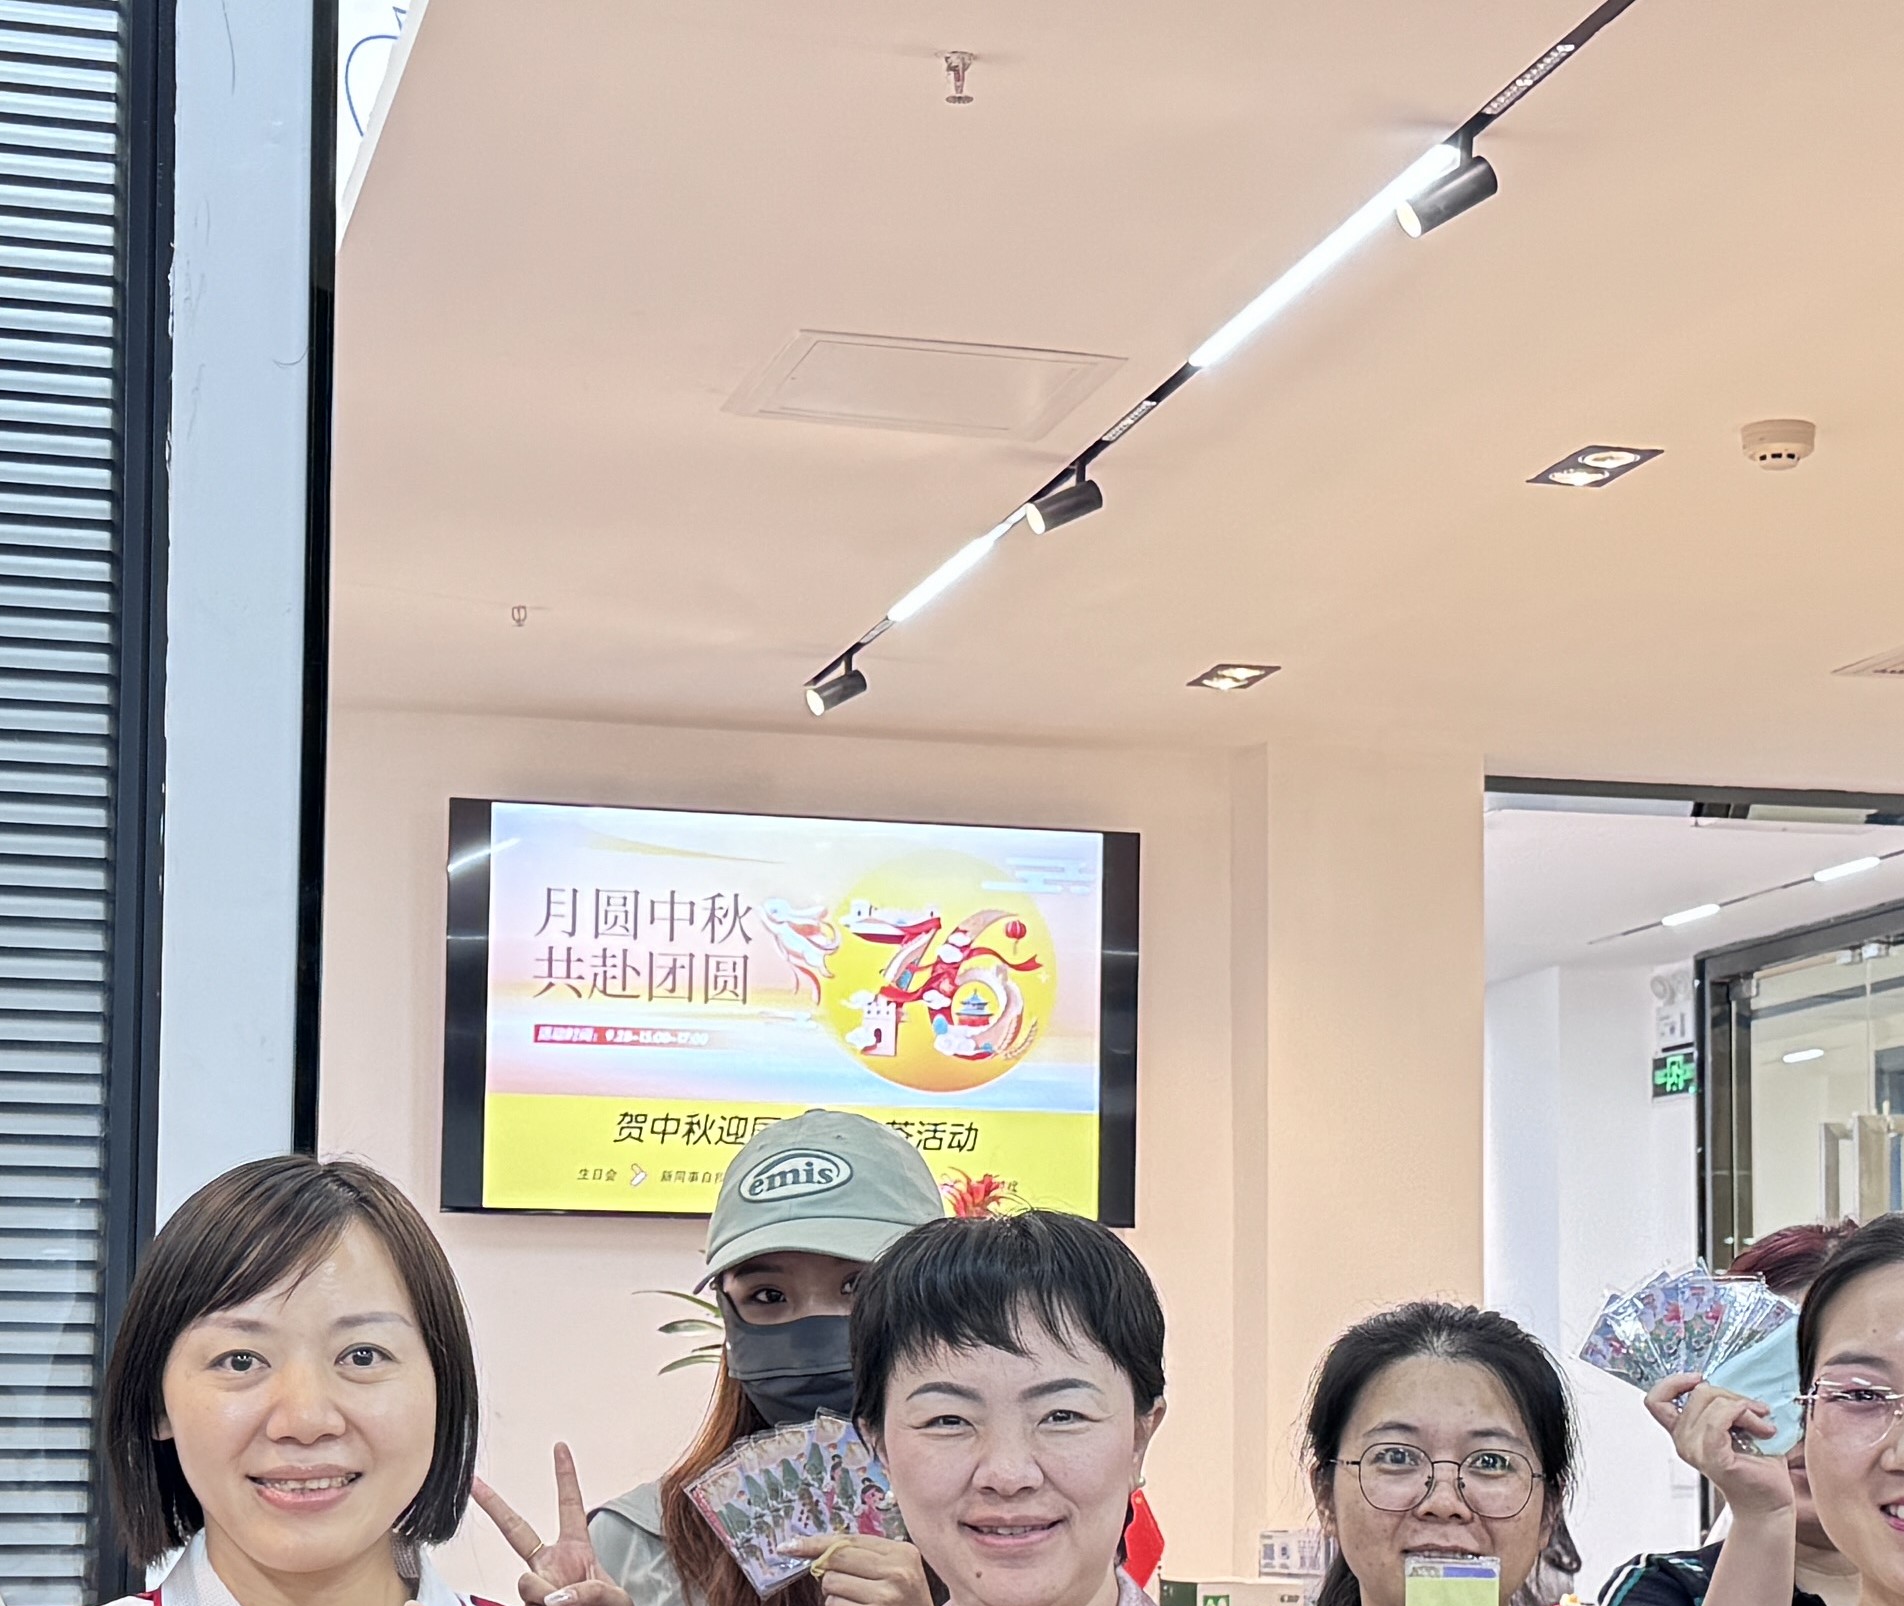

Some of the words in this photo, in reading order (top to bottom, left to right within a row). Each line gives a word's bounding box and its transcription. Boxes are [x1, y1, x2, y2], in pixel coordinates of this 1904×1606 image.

[534, 887, 754, 944] 月圆中秋
[532, 946, 750, 1005] 共赴团圆
[748, 1160, 834, 1196] emis
